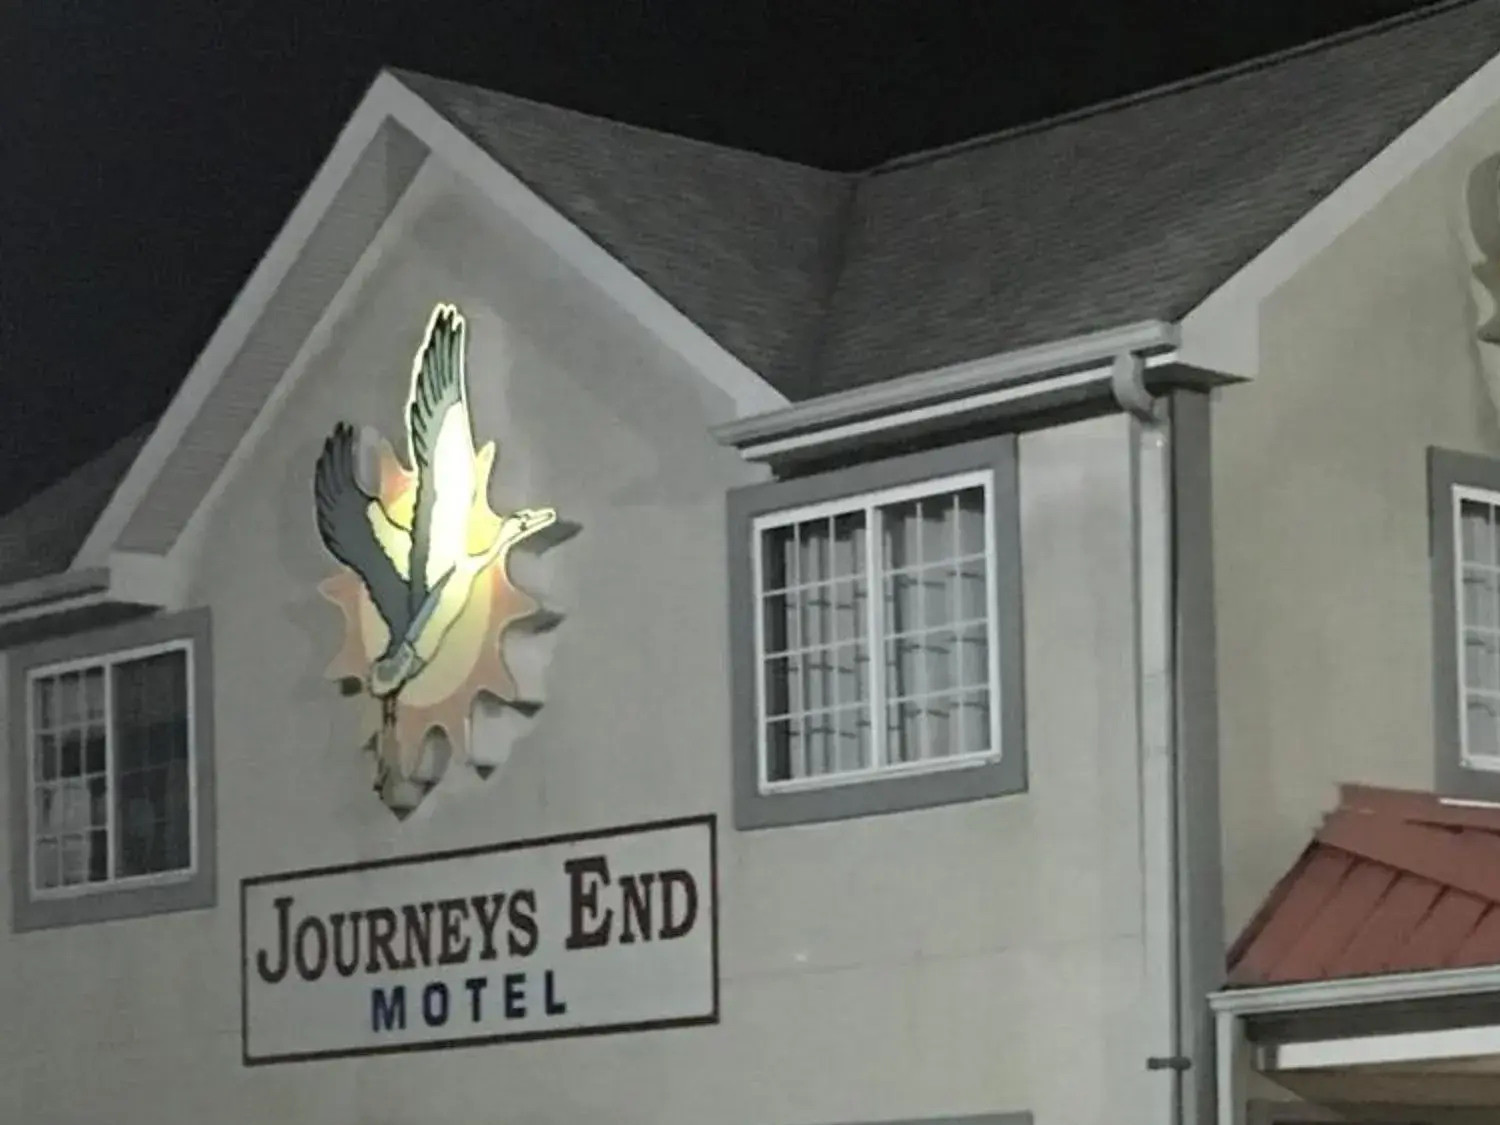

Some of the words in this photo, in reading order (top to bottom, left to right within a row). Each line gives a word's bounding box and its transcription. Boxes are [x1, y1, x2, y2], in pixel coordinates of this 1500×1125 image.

[257, 888, 539, 985] JOURNEYS
[563, 856, 699, 951] END
[371, 971, 567, 1033] MOTEL
